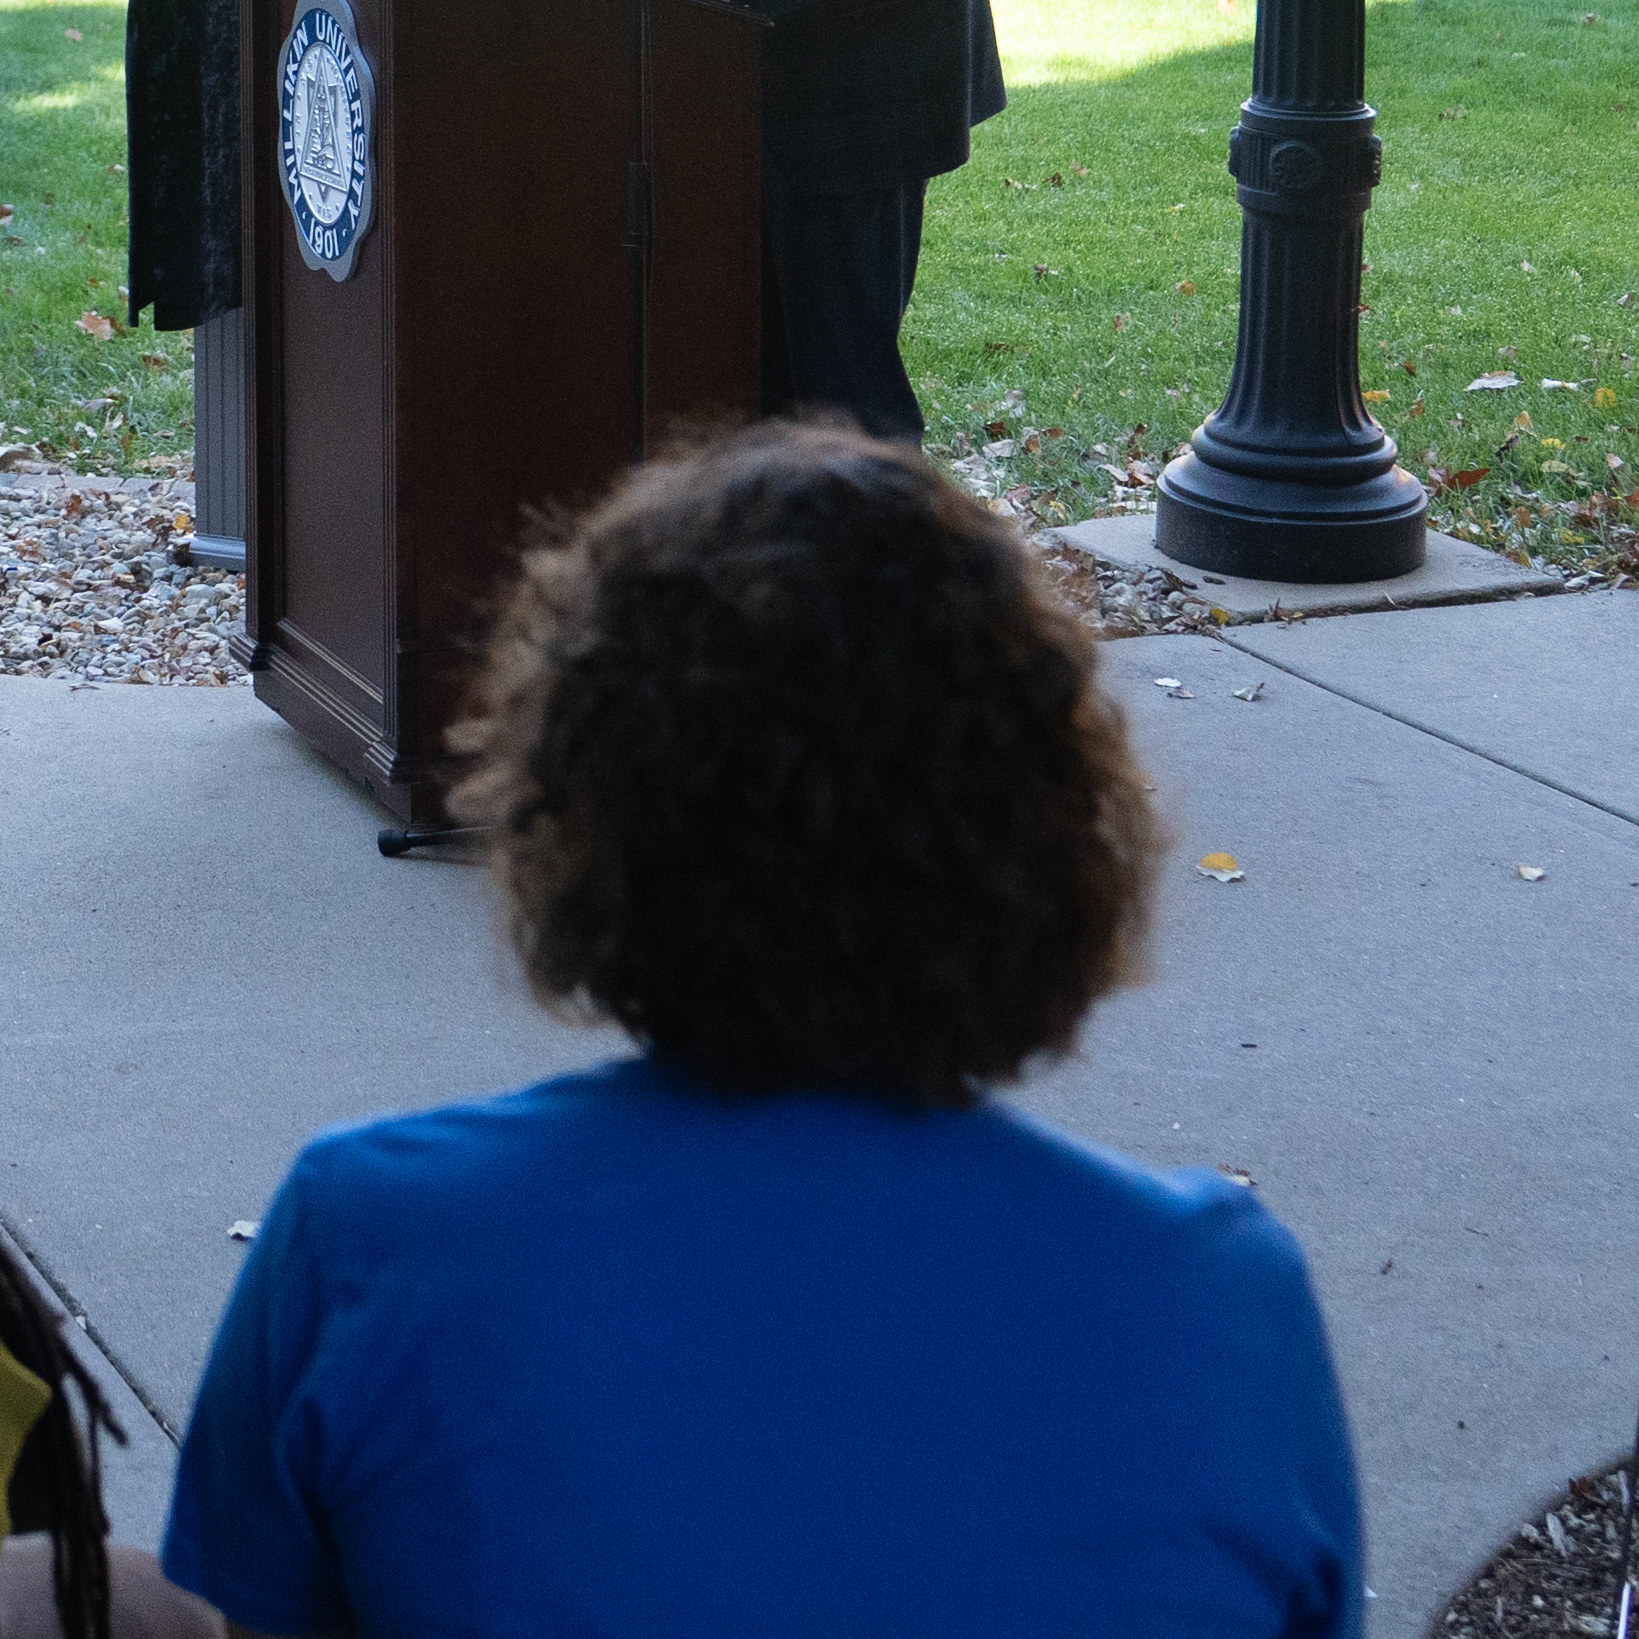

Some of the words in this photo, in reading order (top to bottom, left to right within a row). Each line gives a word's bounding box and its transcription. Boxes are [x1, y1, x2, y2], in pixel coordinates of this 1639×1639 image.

[282, 20, 309, 206] MILLIKIN
[315, 12, 367, 230] UNIVERSITY
[308, 217, 340, 260] 1901
